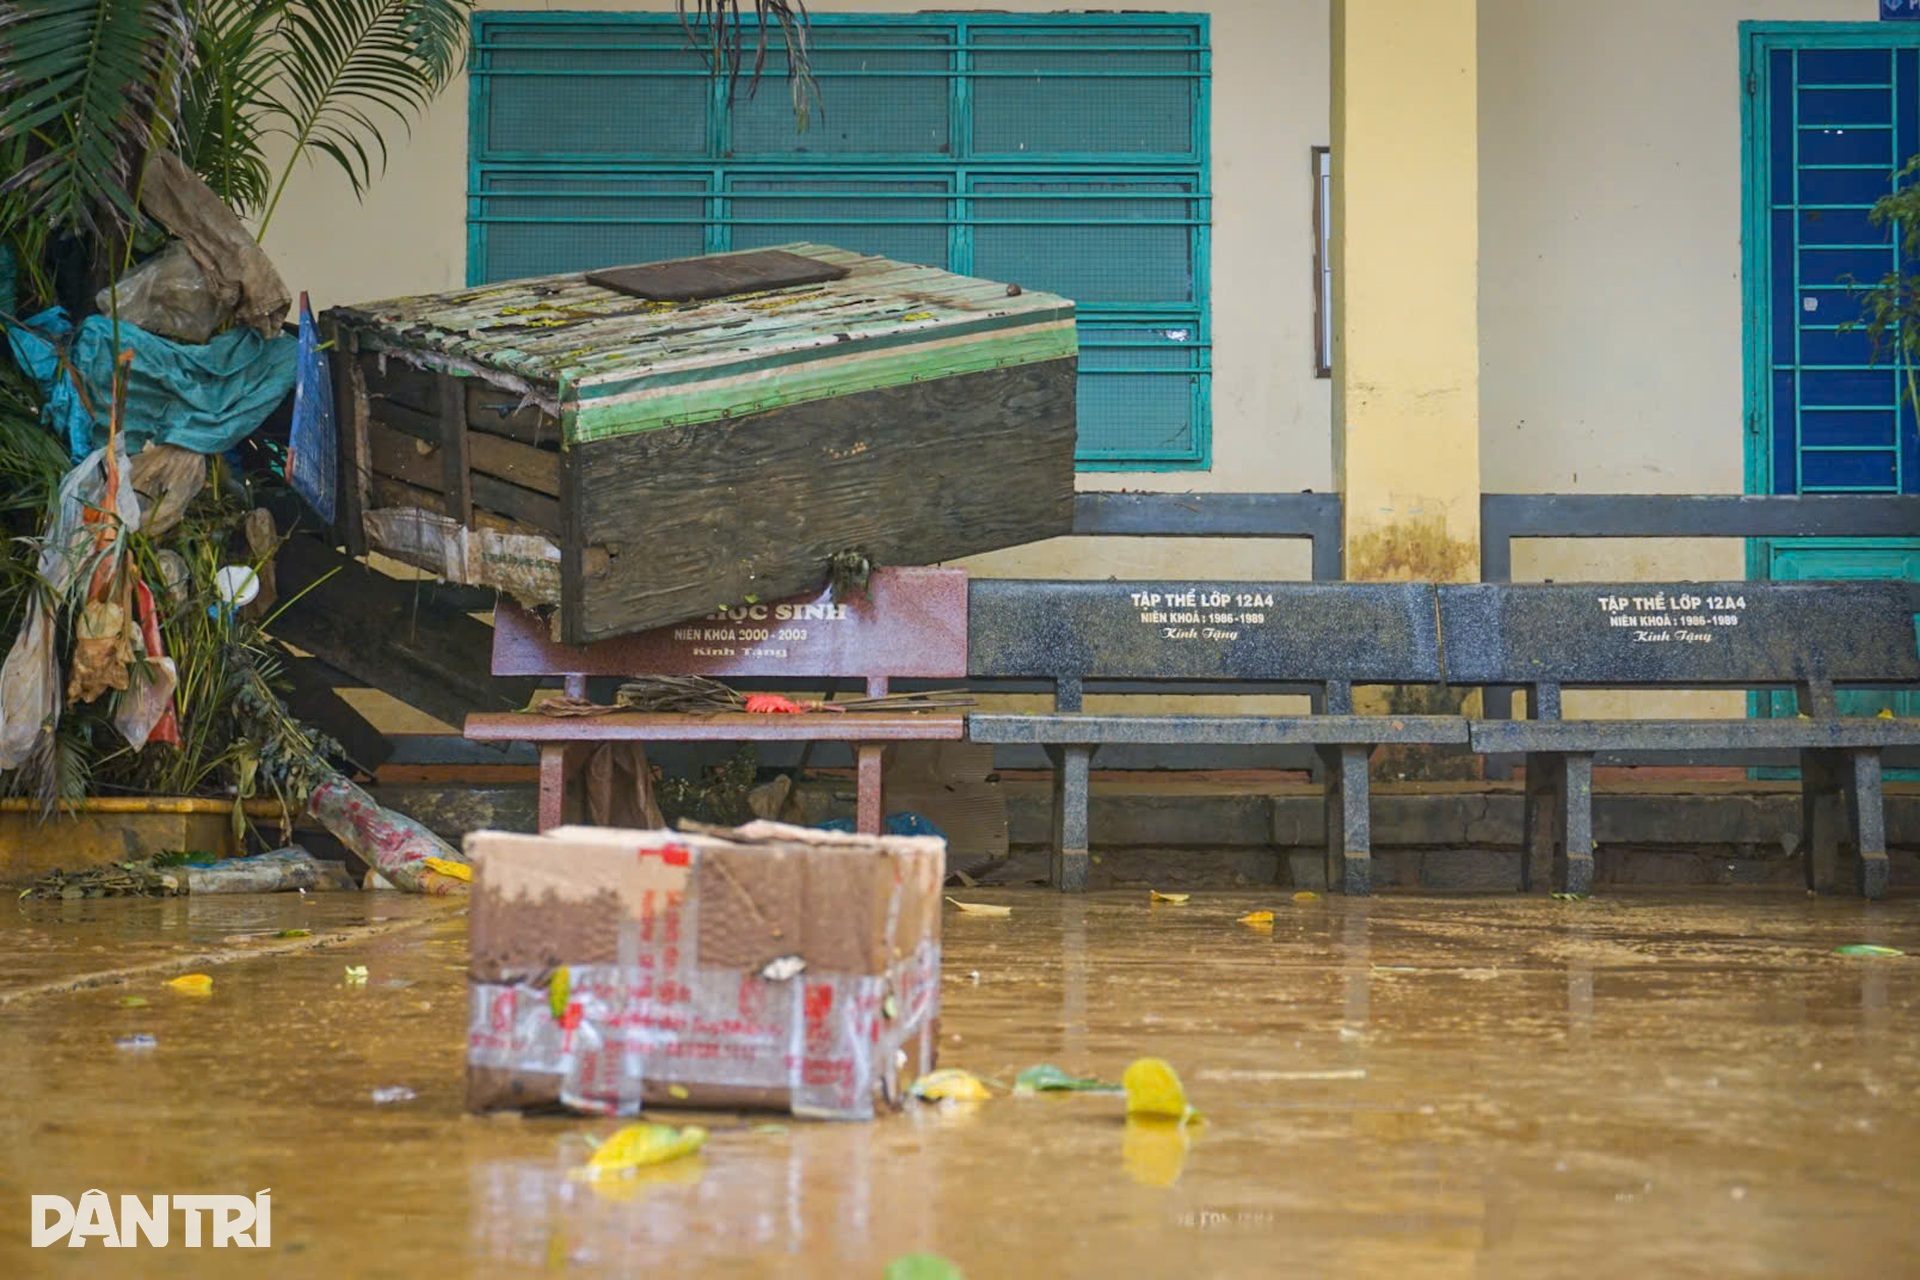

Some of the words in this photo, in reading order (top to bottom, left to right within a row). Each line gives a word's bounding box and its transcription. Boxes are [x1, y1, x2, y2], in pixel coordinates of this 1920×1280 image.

[1131, 591, 1162, 611] TẬP
[1165, 588, 1196, 608] THỂ
[1201, 590, 1232, 608] LỚP
[1235, 593, 1274, 608] 12A4
[1598, 595, 1630, 615] TẬP
[1633, 591, 1666, 611] THỂ
[1671, 594, 1702, 610] LỚP
[1706, 596, 1747, 610] 12A4
[775, 603, 848, 621] SINH
[1141, 610, 1168, 624] NIÊN
[1610, 613, 1637, 627] NIÊN
[674, 626, 701, 641] NIÊN
[739, 628, 769, 641] 2000
[778, 628, 808, 641] 2003
